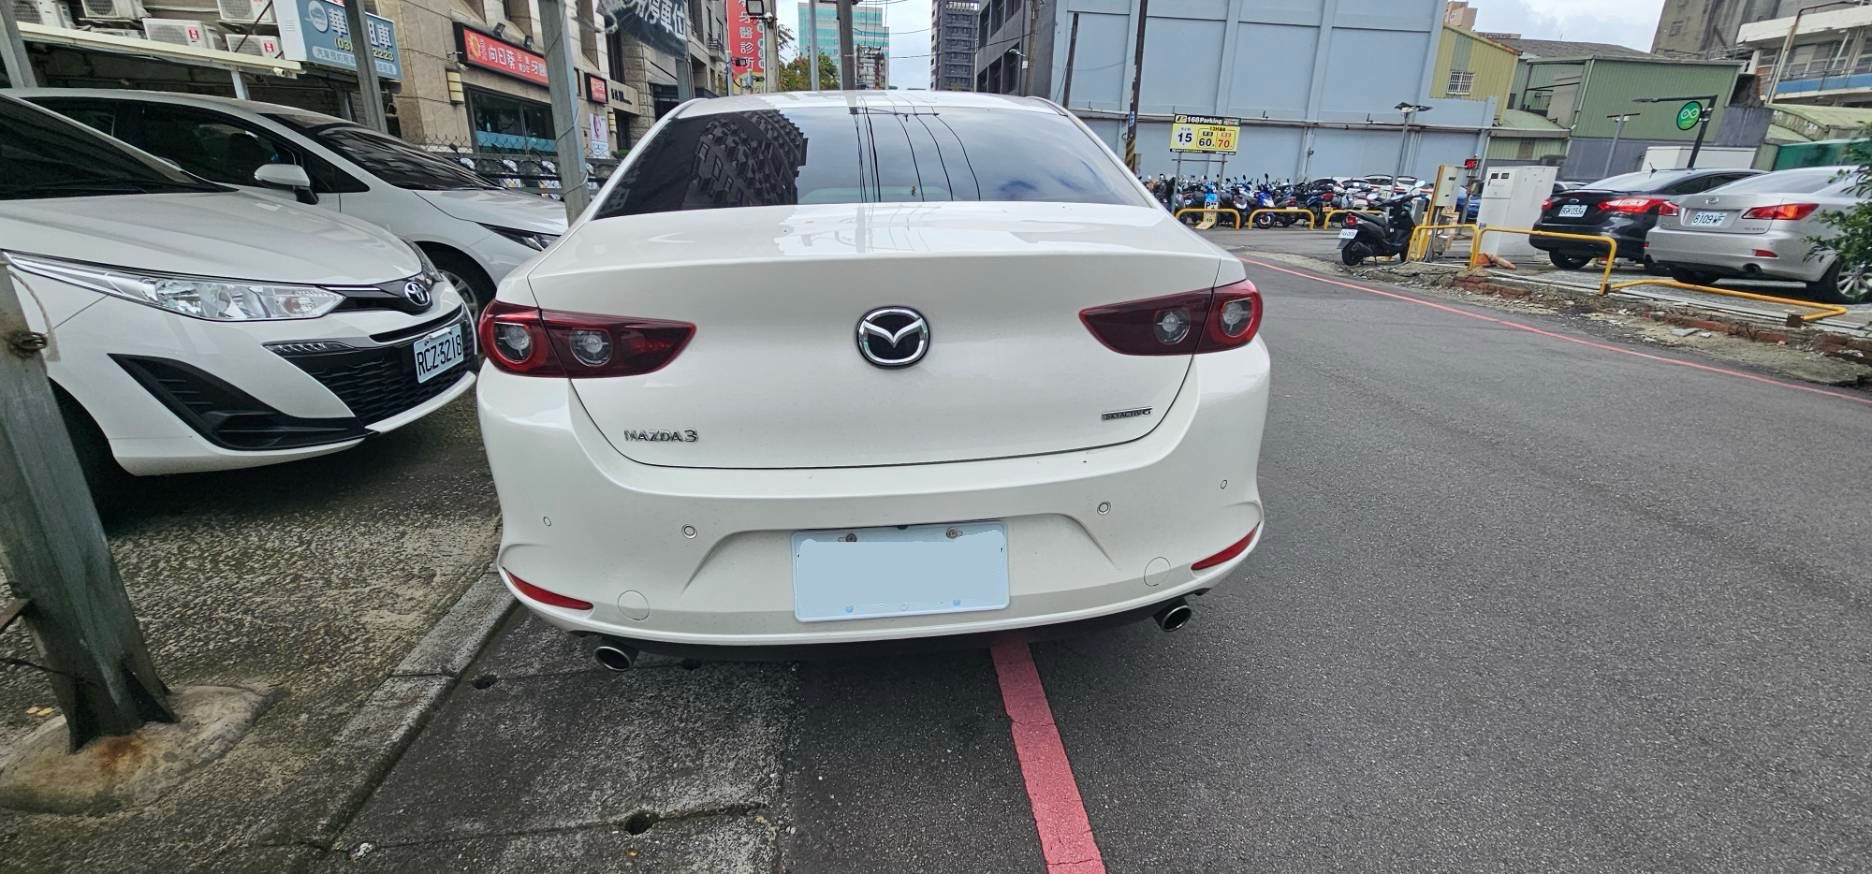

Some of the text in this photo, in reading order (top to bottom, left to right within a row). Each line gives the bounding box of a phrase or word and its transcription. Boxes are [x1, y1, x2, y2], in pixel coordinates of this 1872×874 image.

[1178, 132, 1192, 143] 15
[1198, 138, 1212, 147] 60
[1218, 139, 1230, 148] 70
